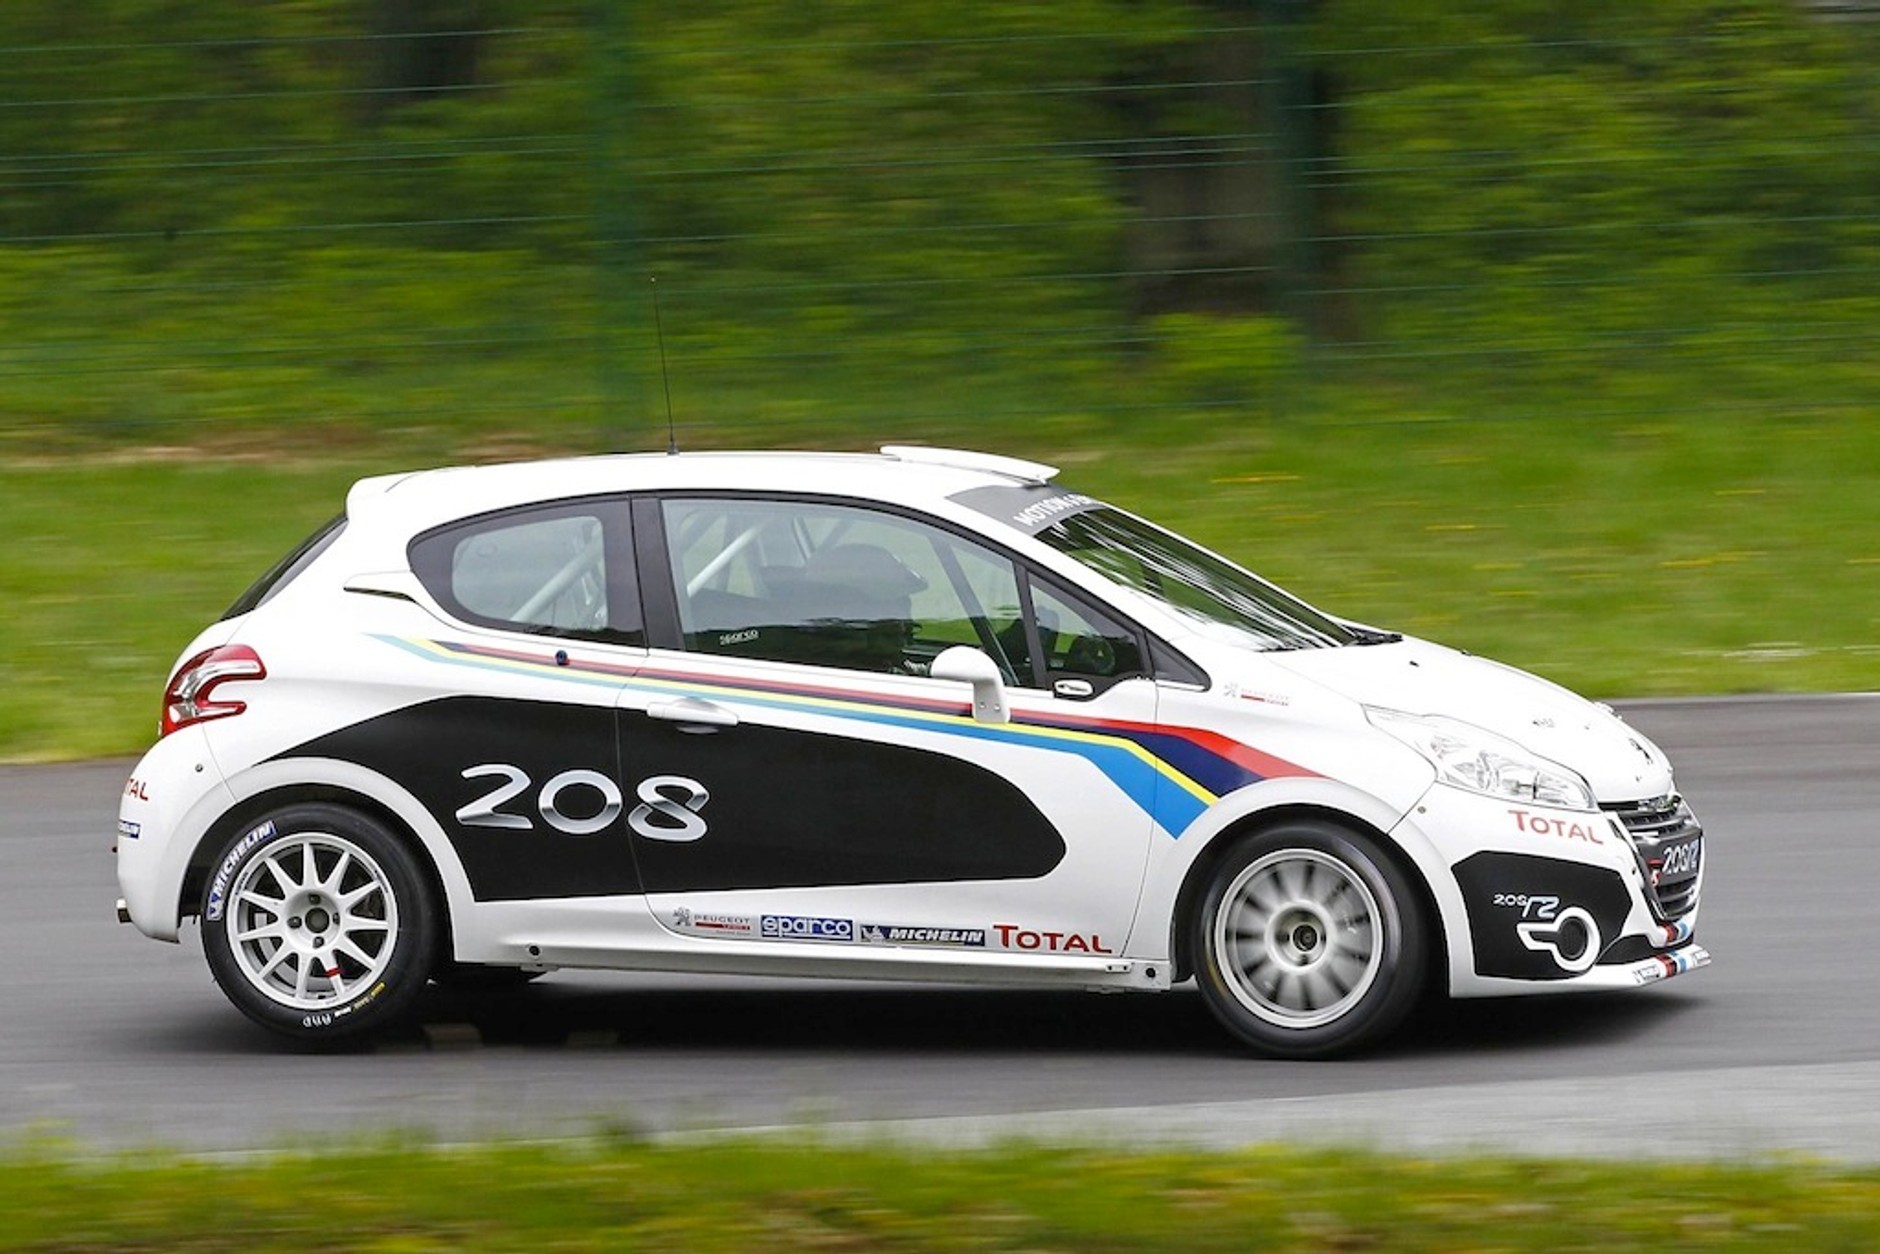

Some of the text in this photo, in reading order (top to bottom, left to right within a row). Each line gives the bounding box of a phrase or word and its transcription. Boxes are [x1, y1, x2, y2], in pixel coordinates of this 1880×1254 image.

[455, 763, 710, 842] 208
[1508, 809, 1604, 845] TOTAL
[211, 820, 274, 897] MICHELIN
[694, 914, 1112, 954] PEUGEOT sparco MICHELIN TOTAL
